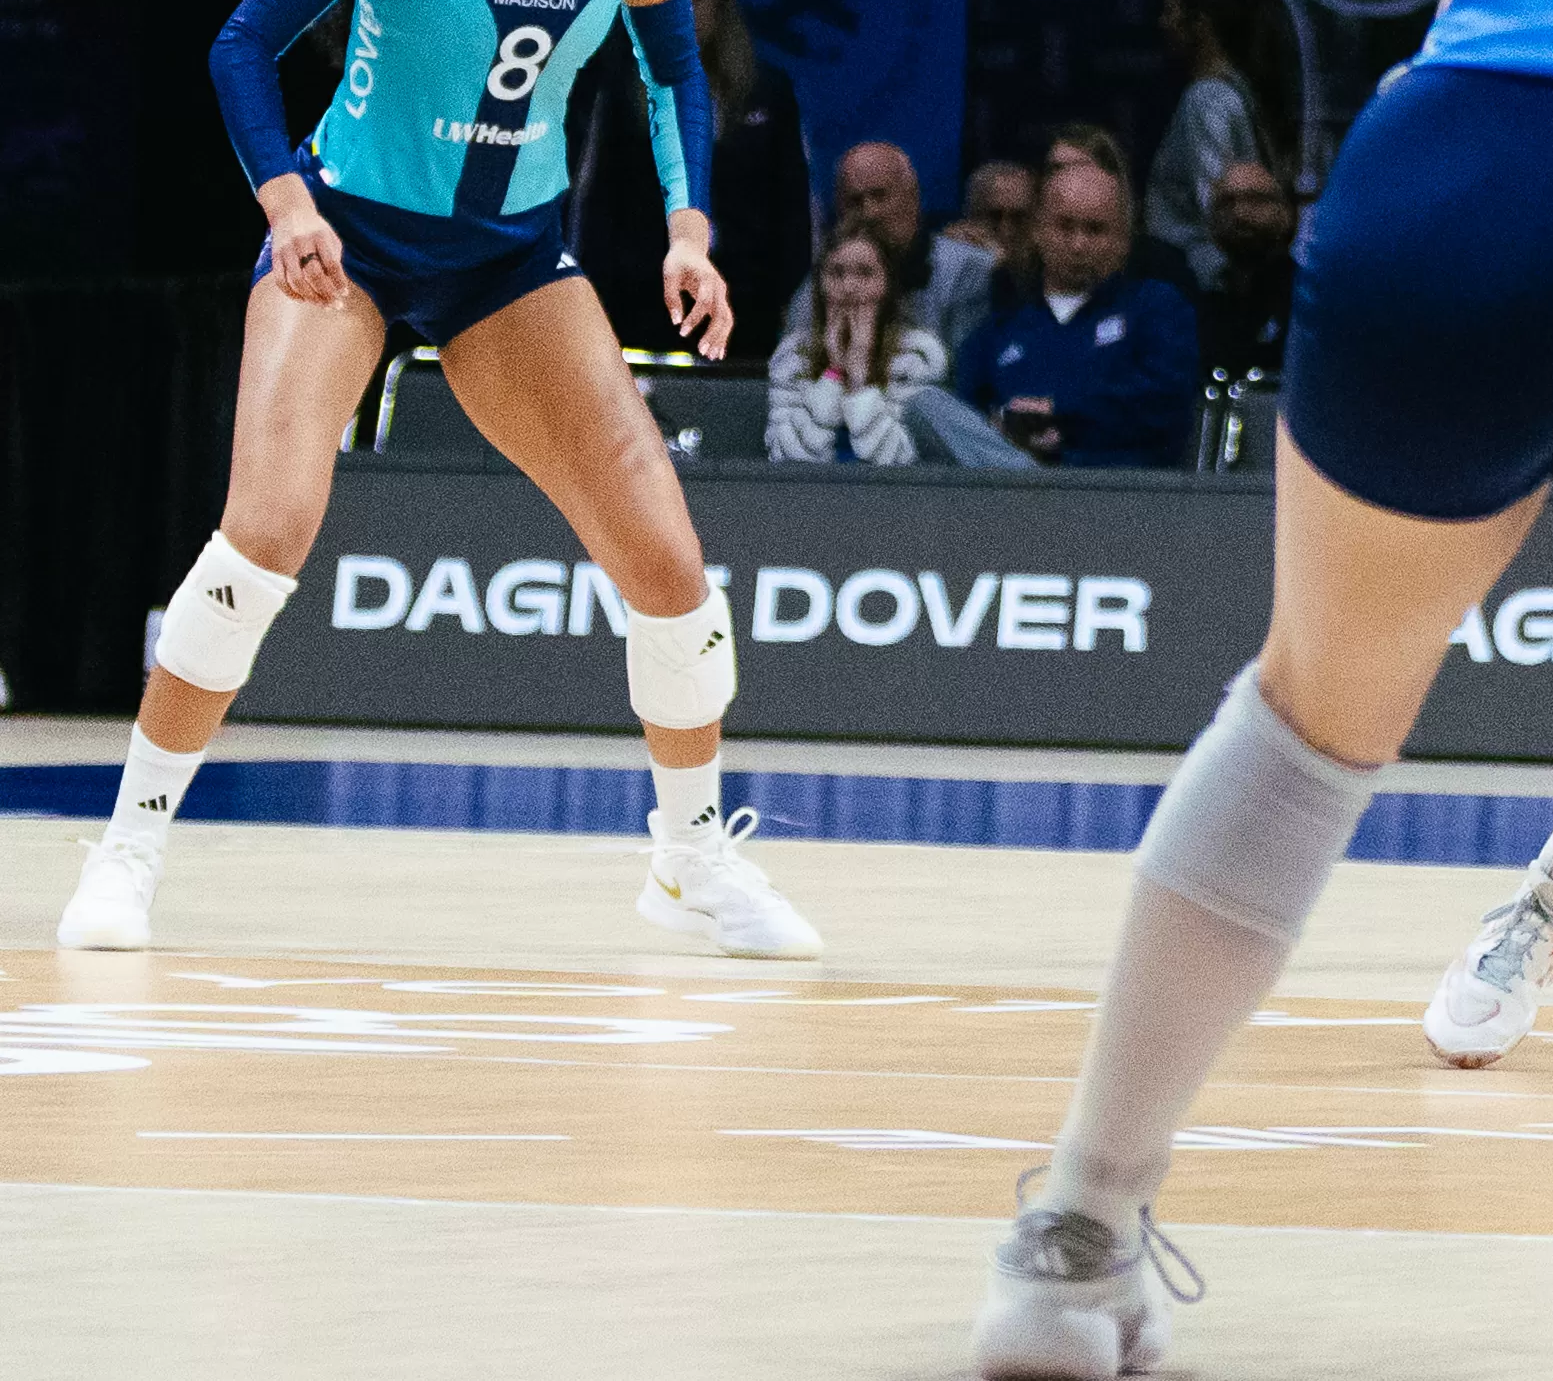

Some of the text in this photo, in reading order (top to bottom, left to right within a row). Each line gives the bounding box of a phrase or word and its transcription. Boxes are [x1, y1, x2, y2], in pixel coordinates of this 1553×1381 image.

[487, 25, 552, 101] 8
[333, 554, 1152, 653] DAGN DOVER
